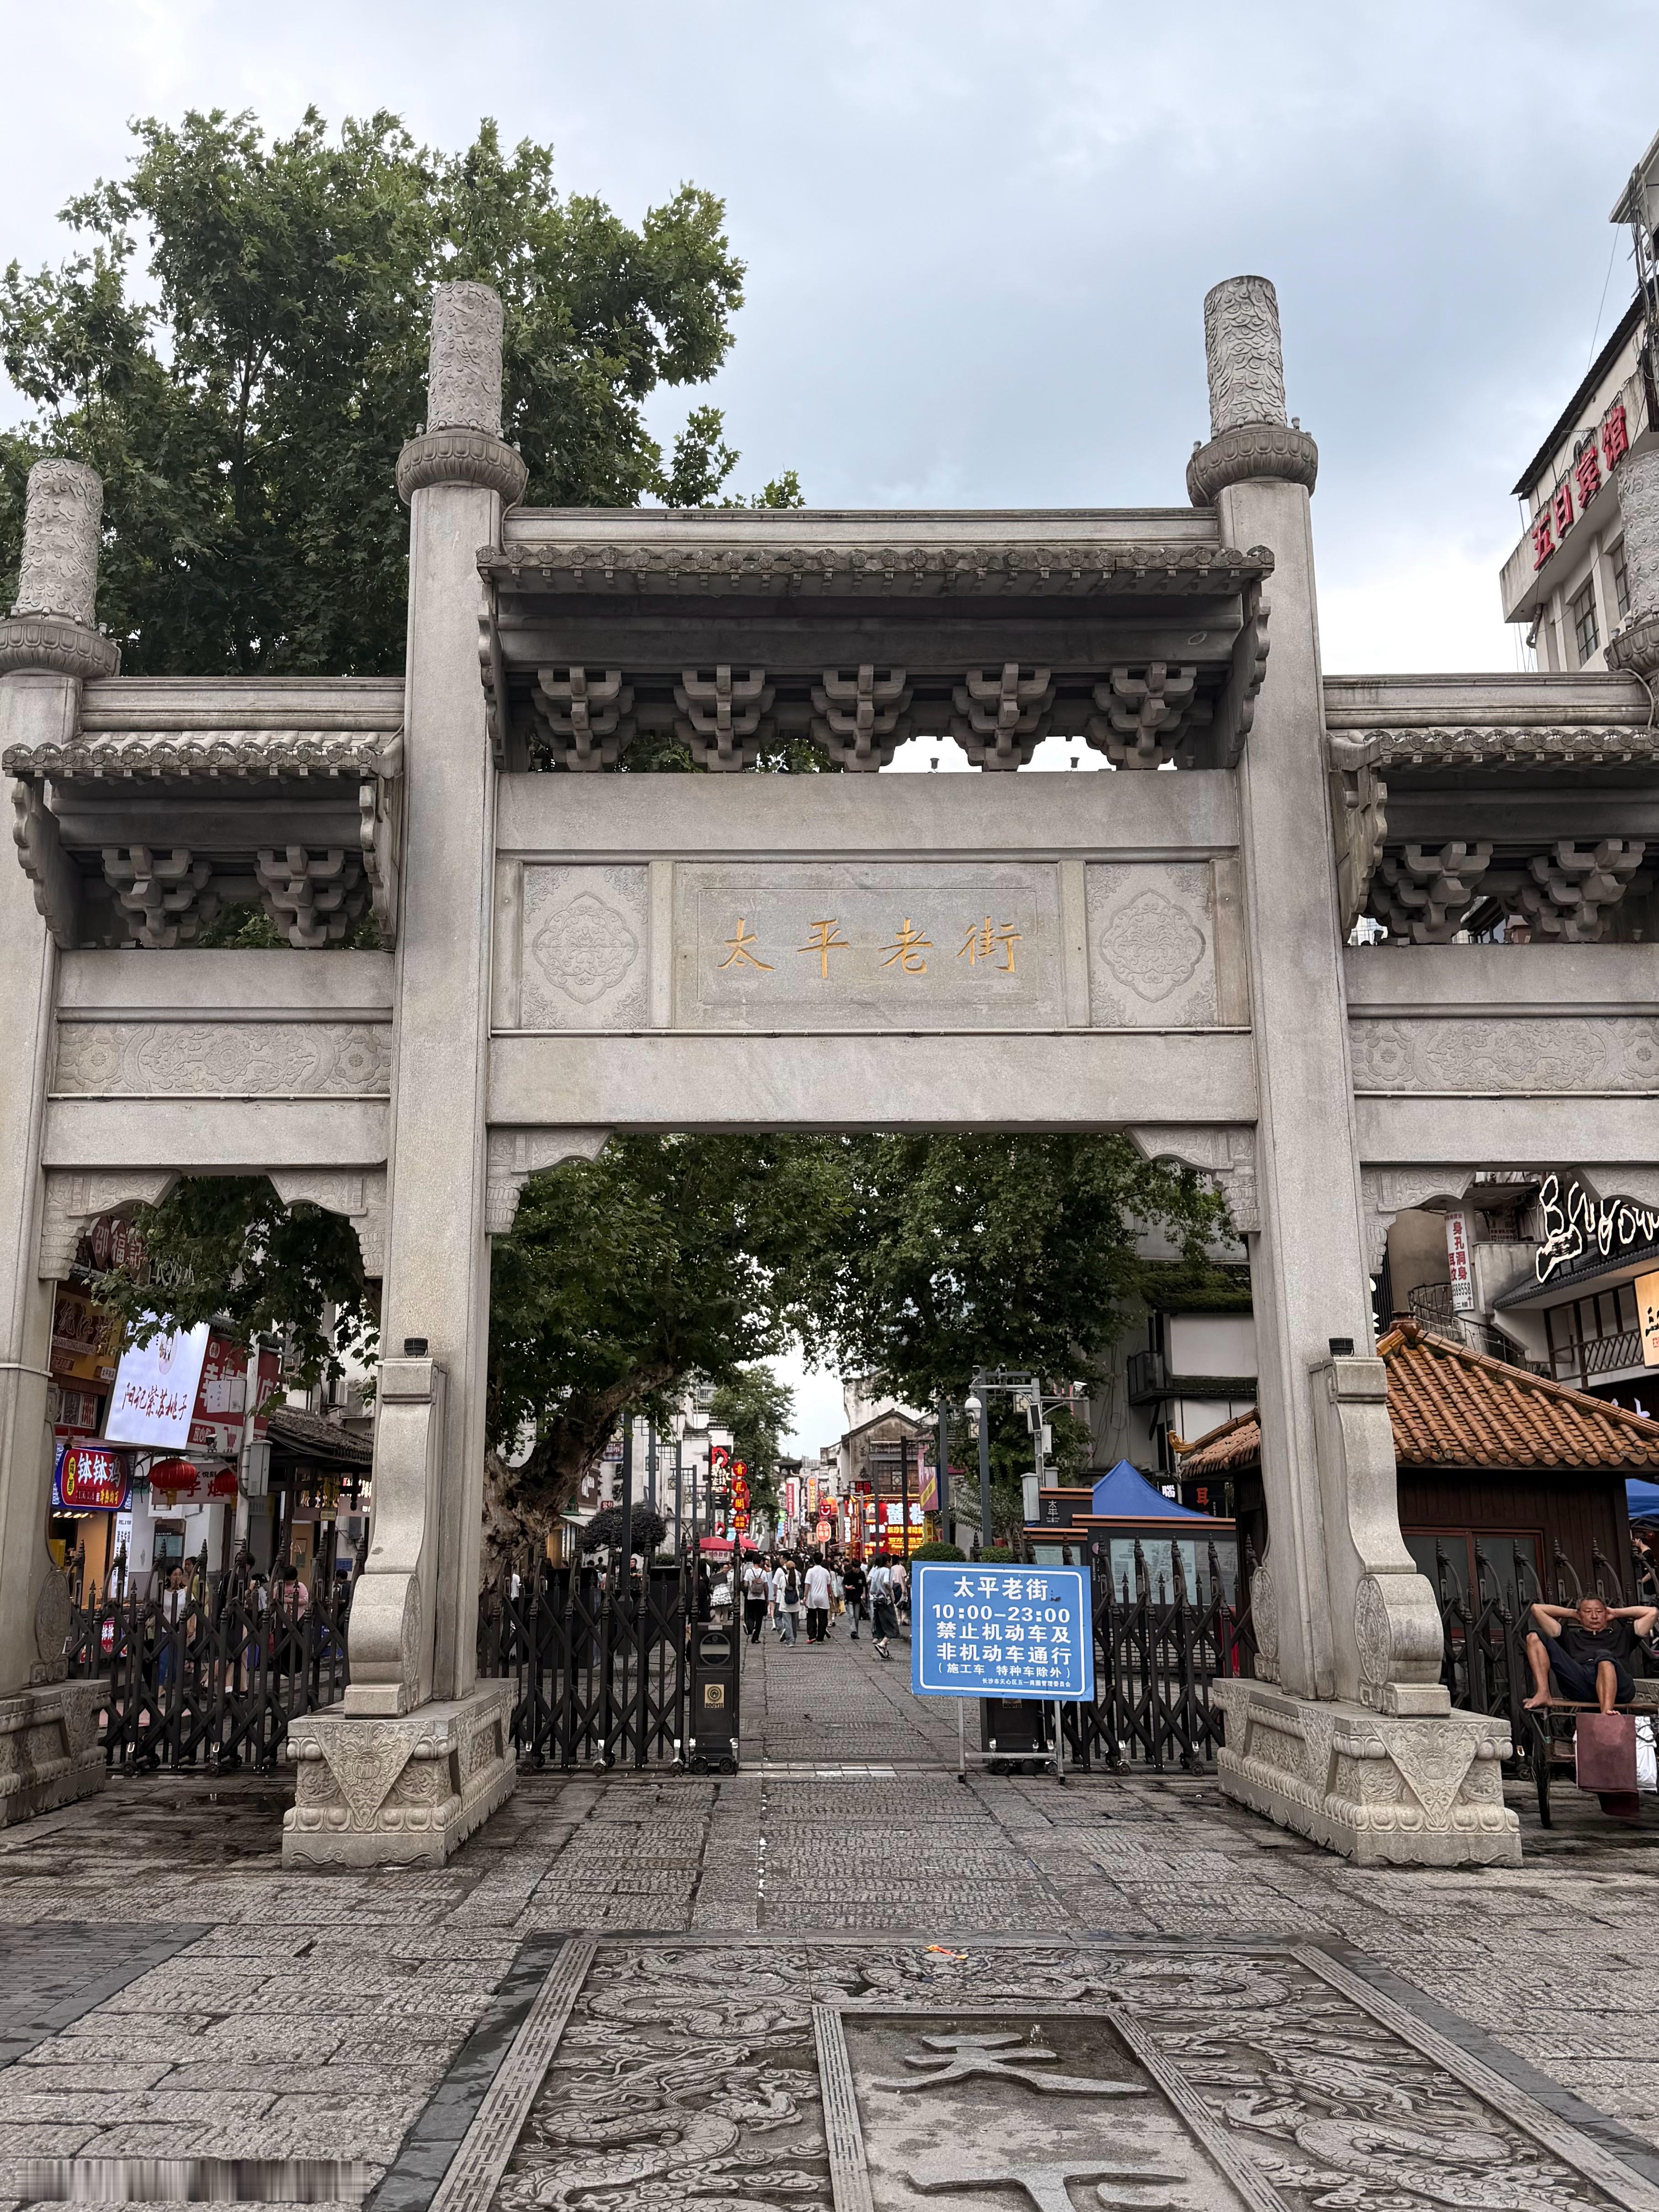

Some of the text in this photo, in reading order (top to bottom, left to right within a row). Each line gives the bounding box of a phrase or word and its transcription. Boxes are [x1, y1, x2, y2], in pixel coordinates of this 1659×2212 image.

[1532, 406, 1629, 571] 五日宾馆
[716, 916, 1023, 978] 太平老街
[77, 1452, 121, 1488] 钵钵鸡
[1047, 1500, 1058, 1517] 太平
[953, 1575, 1049, 1601] 太平老街
[936, 1621, 1071, 1644] 禁止机动车及
[936, 1642, 1072, 1665] 非机动车通行
[982, 1678, 1071, 1688] 长沙市天心区五一商圈管理委员会
